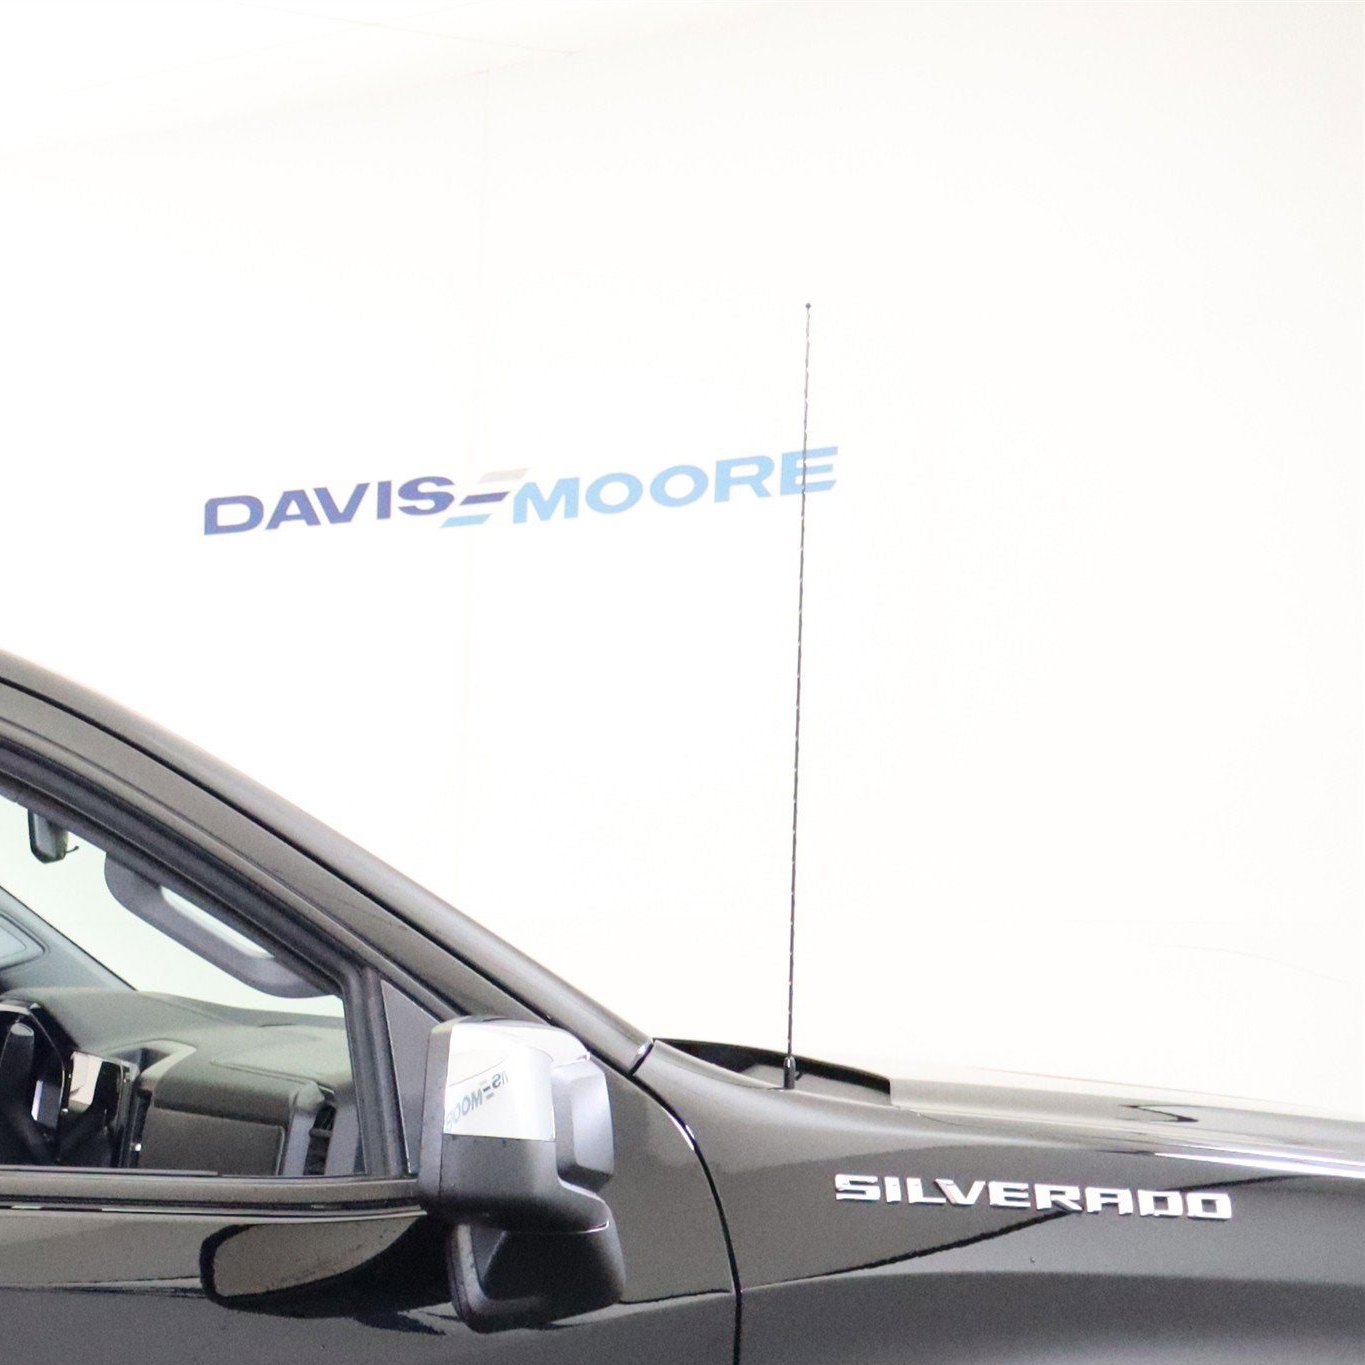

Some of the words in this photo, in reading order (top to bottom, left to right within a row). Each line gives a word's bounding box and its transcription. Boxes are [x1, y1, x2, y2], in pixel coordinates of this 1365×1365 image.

[203, 476, 456, 536] DAVIS
[512, 445, 838, 524] MOORE
[834, 1173, 1233, 1220] SILVERADO
